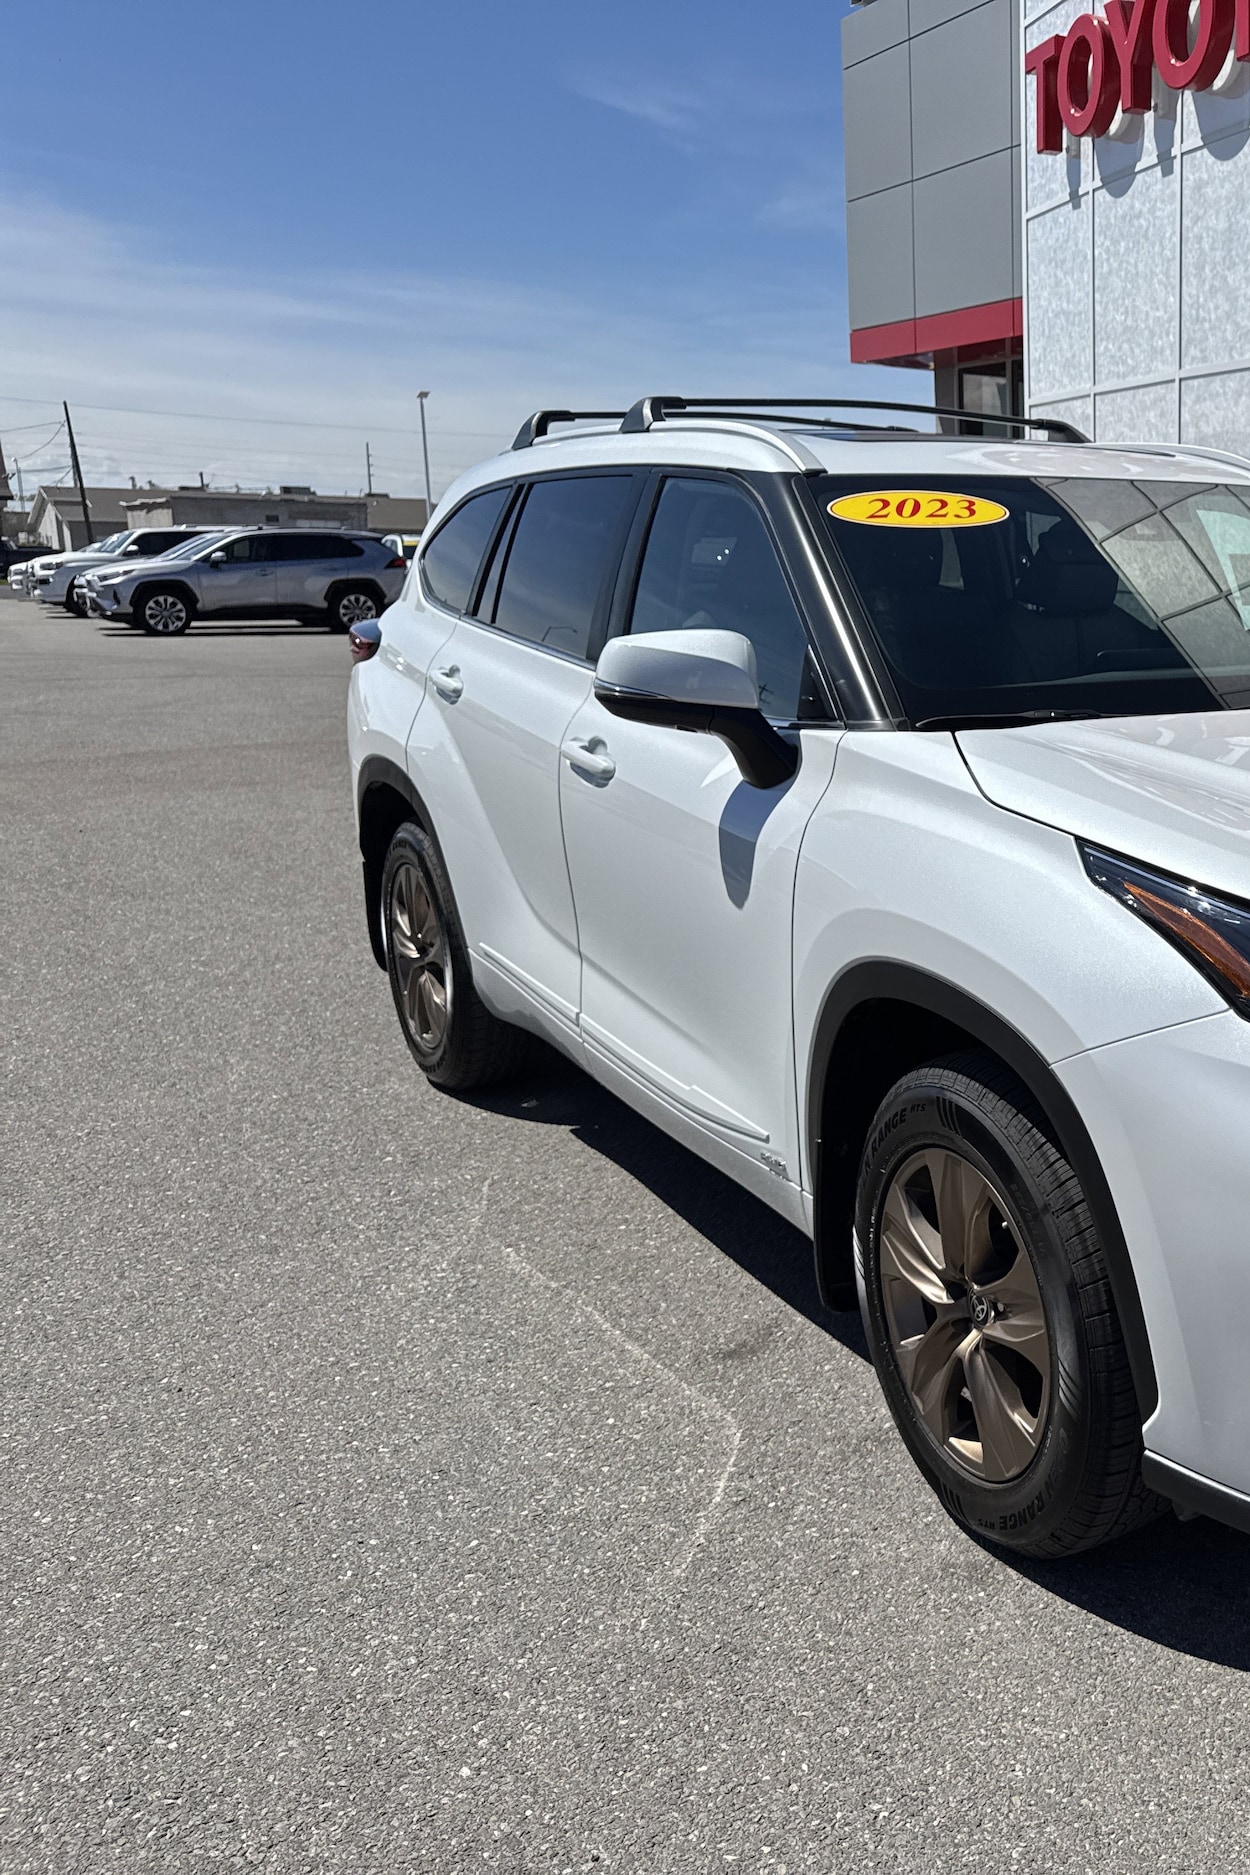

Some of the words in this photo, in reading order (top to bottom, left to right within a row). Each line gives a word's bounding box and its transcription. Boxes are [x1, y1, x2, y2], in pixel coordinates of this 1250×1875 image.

[865, 497, 977, 519] 2023
[871, 1106, 907, 1158] RANGE
[1000, 1491, 1045, 1530] RANGE
